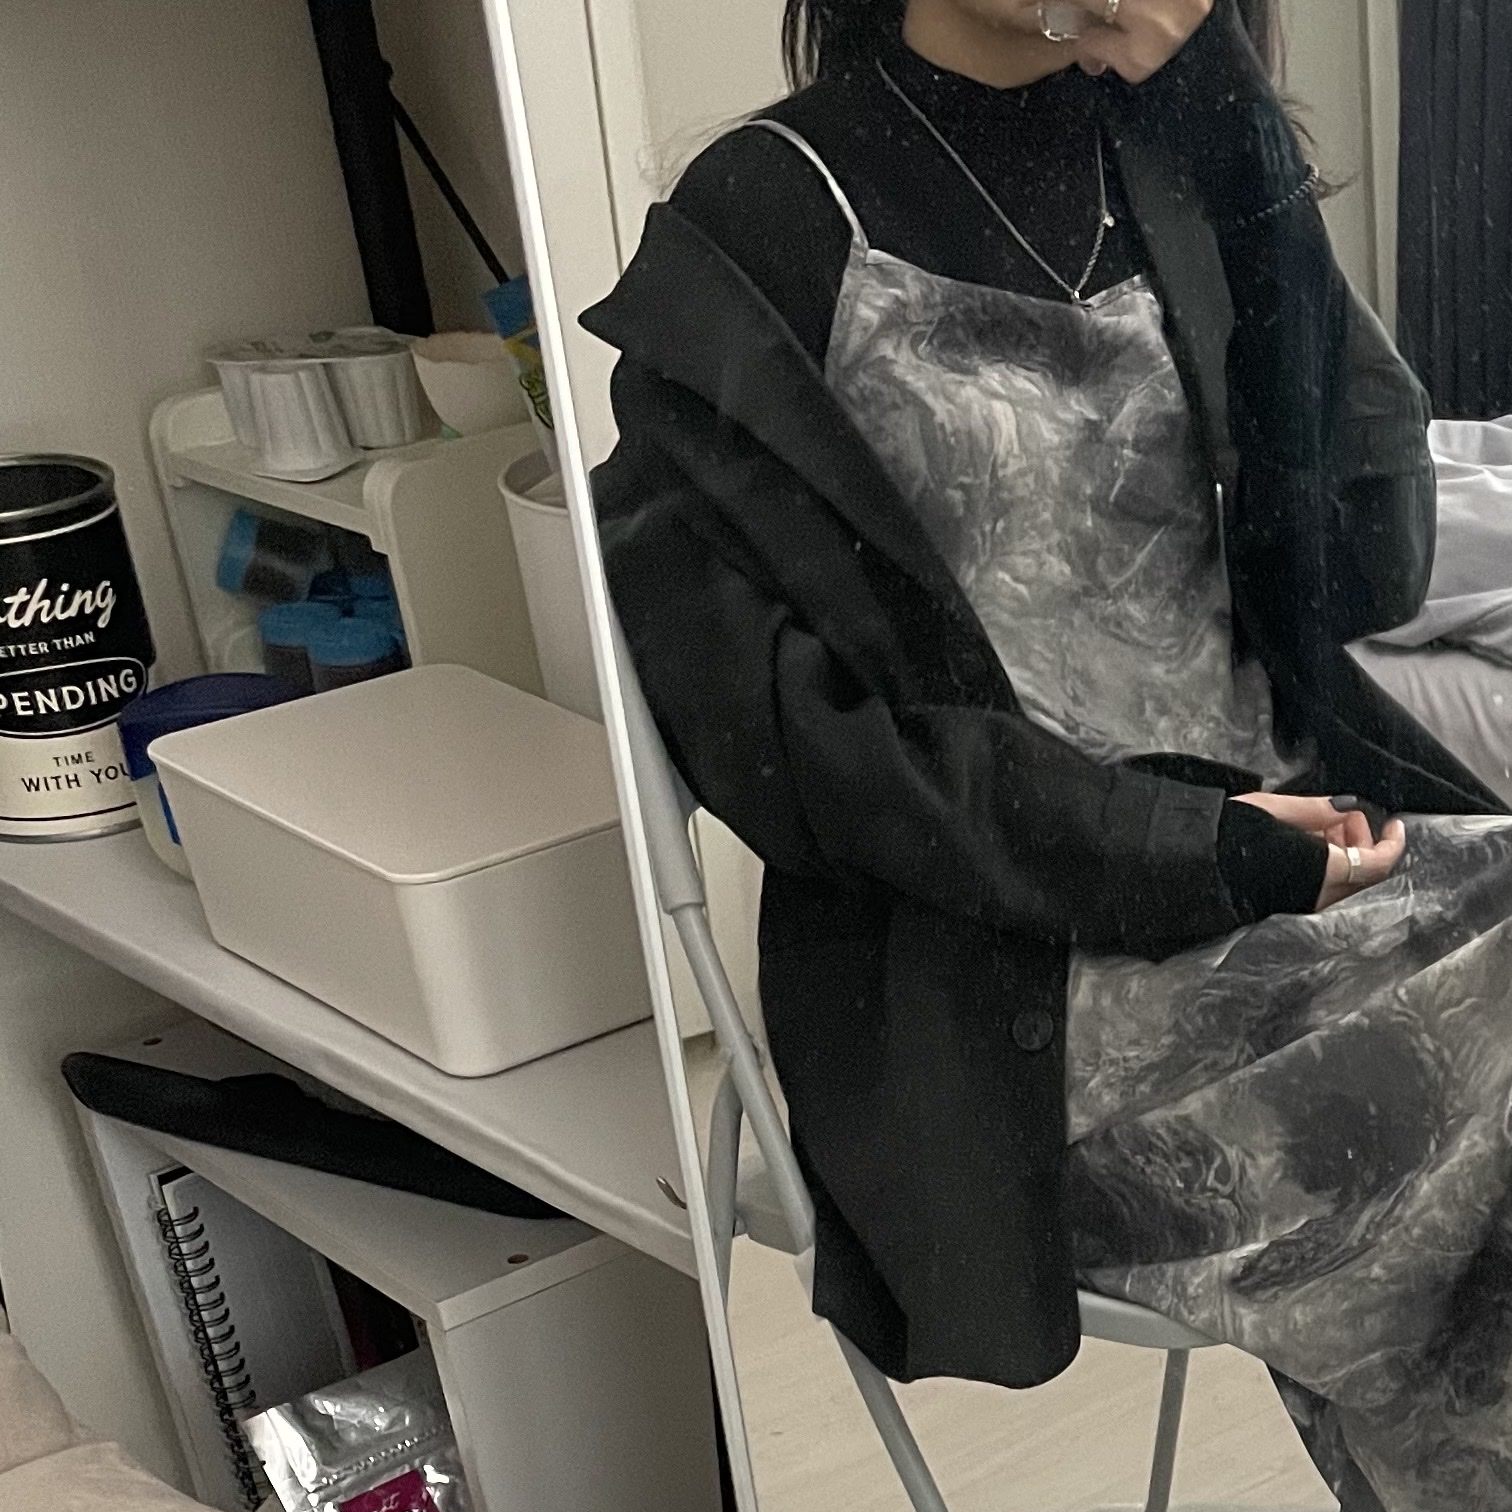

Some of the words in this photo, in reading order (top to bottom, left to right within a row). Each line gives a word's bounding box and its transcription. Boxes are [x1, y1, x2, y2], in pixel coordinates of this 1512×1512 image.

[0, 578, 117, 628] thing
[52, 631, 96, 651] THAN
[52, 752, 95, 768] TIME
[21, 773, 82, 793] WITH
